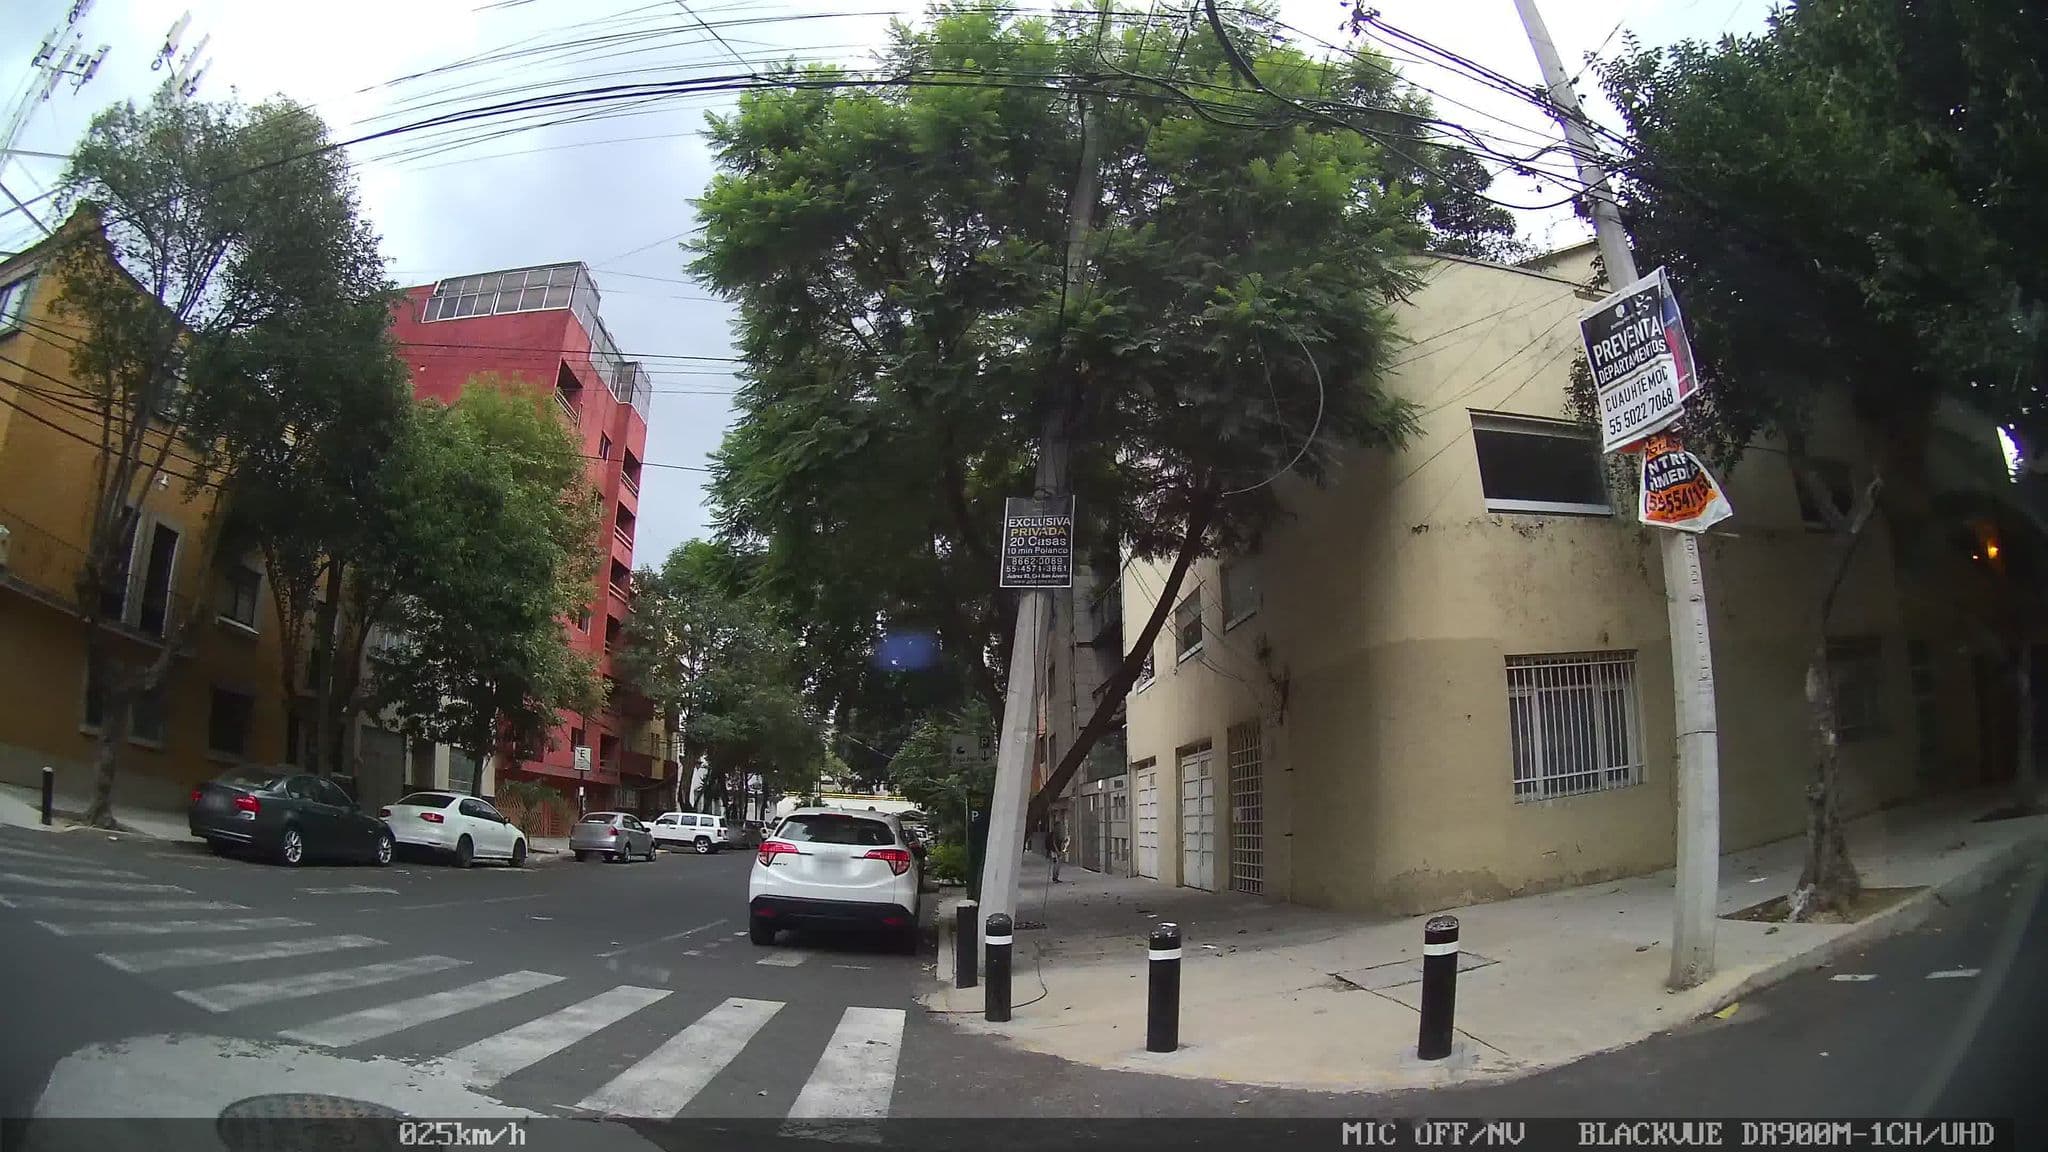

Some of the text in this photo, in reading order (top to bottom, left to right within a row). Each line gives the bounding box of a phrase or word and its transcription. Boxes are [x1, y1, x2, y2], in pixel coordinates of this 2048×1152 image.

[1592, 316, 1662, 367] PREVENTA
[1598, 339, 1666, 384] DEPARTAMENTOS
[1605, 366, 1668, 412] CUAUHTEMOC
[1609, 388, 1674, 435] 55 5022 7068
[1008, 517, 1071, 527] EXCLUSIVA
[1011, 527, 1067, 537] PRIVADA
[1010, 536, 1067, 547] 20 Casas
[1035, 546, 1069, 554] Polanco
[971, 810, 980, 823] P
